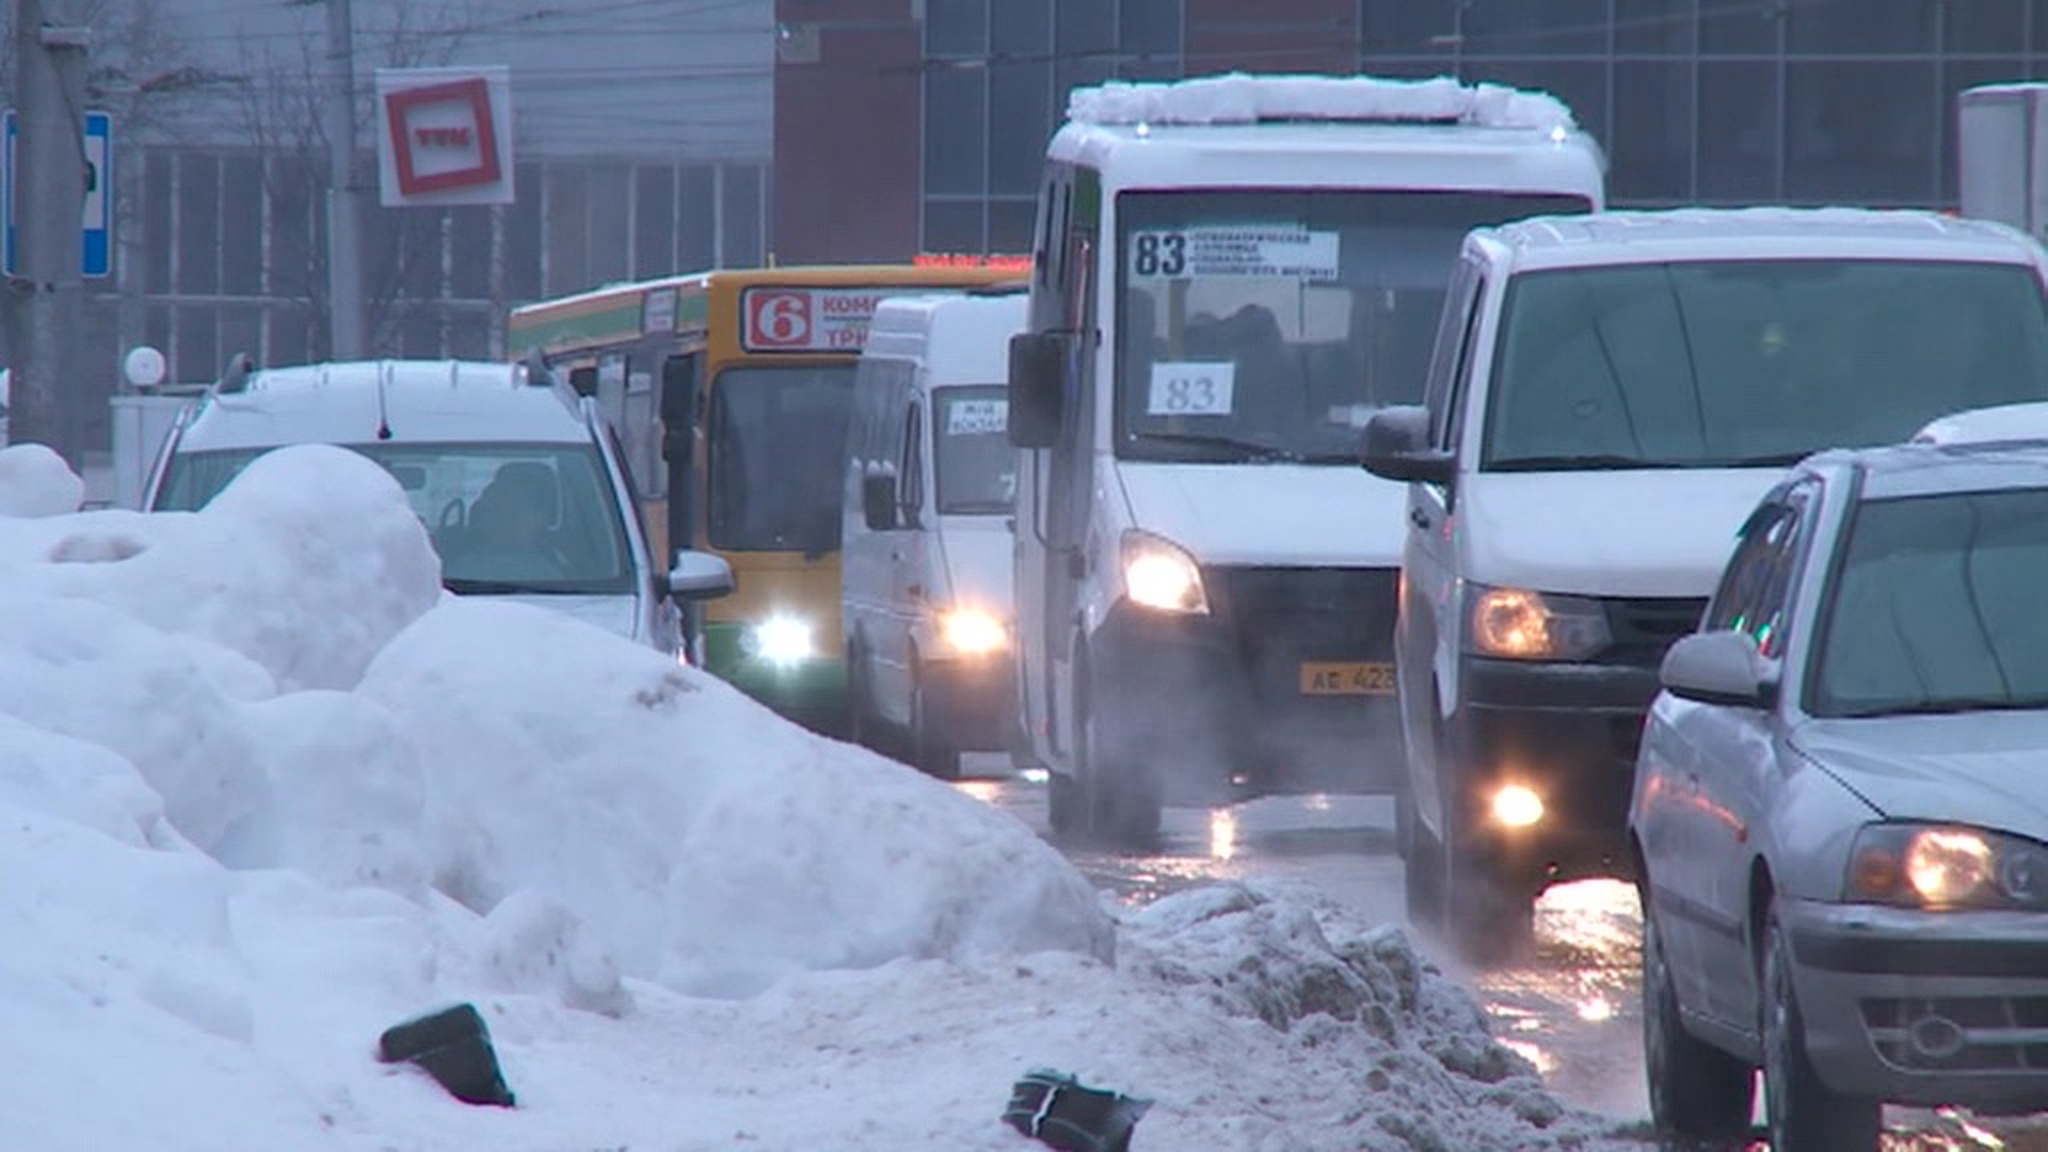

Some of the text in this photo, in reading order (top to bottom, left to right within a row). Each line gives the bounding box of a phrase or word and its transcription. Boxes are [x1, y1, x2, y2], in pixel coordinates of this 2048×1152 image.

[1136, 233, 1187, 276] 83
[758, 296, 807, 341] 6
[1166, 377, 1217, 410] 83
